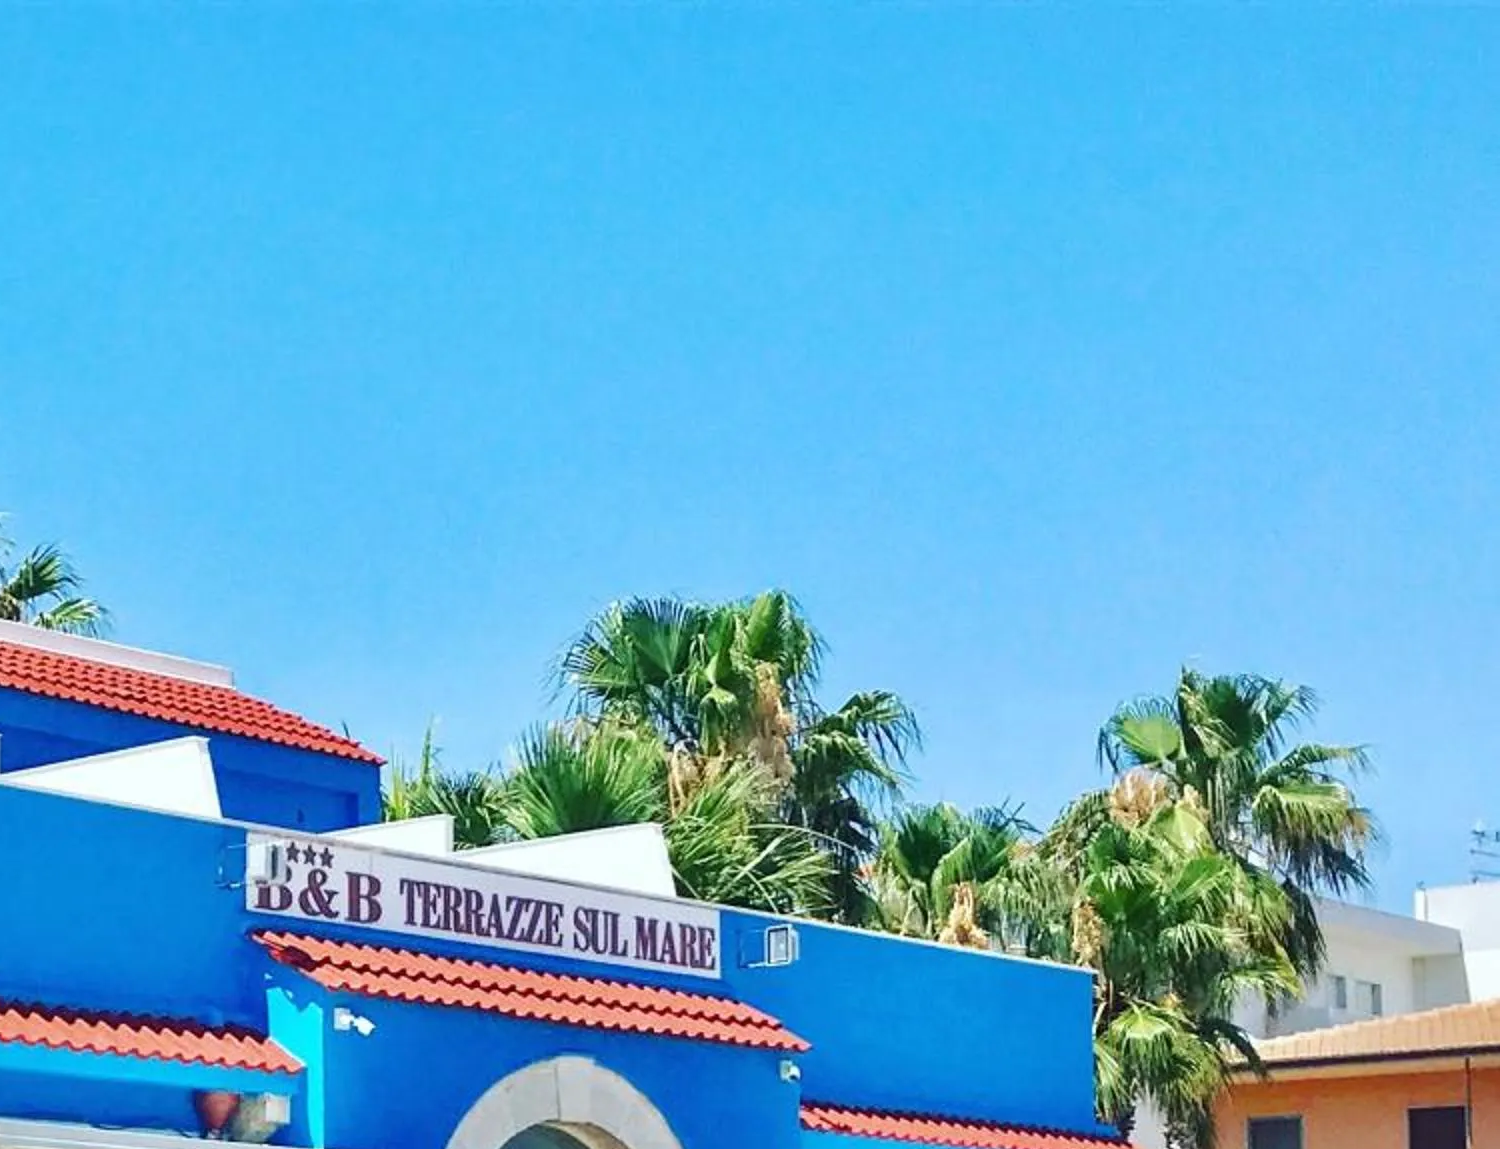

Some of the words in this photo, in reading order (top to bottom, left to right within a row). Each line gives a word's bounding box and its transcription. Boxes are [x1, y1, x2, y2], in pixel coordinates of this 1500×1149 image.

[254, 865, 382, 923] B&B
[399, 878, 564, 947] TERRAZZE
[573, 906, 628, 957] SUL
[634, 915, 716, 970] MARE
